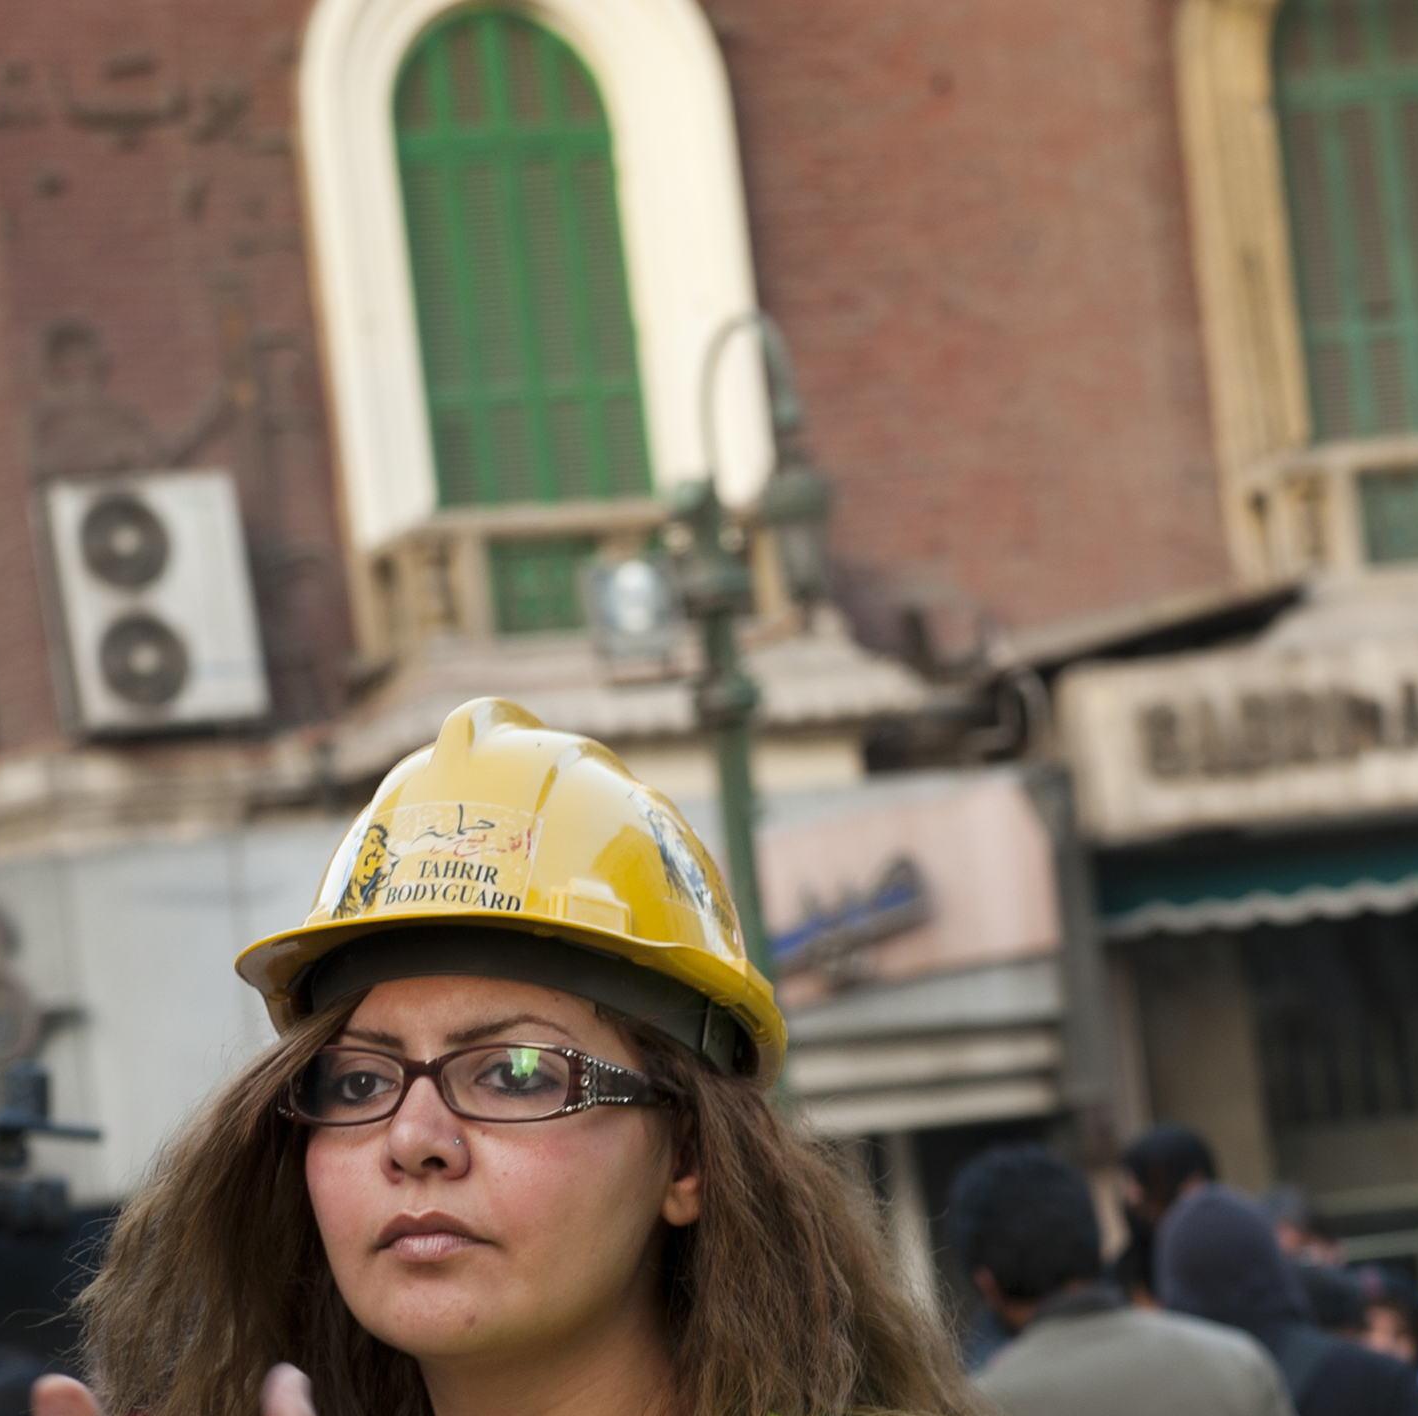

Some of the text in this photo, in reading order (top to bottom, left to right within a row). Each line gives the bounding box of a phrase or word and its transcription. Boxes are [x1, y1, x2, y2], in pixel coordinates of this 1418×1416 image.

[410, 803, 496, 847] حماية
[419, 860, 499, 886] TAHRIR
[384, 882, 522, 913] BODYGUARD
